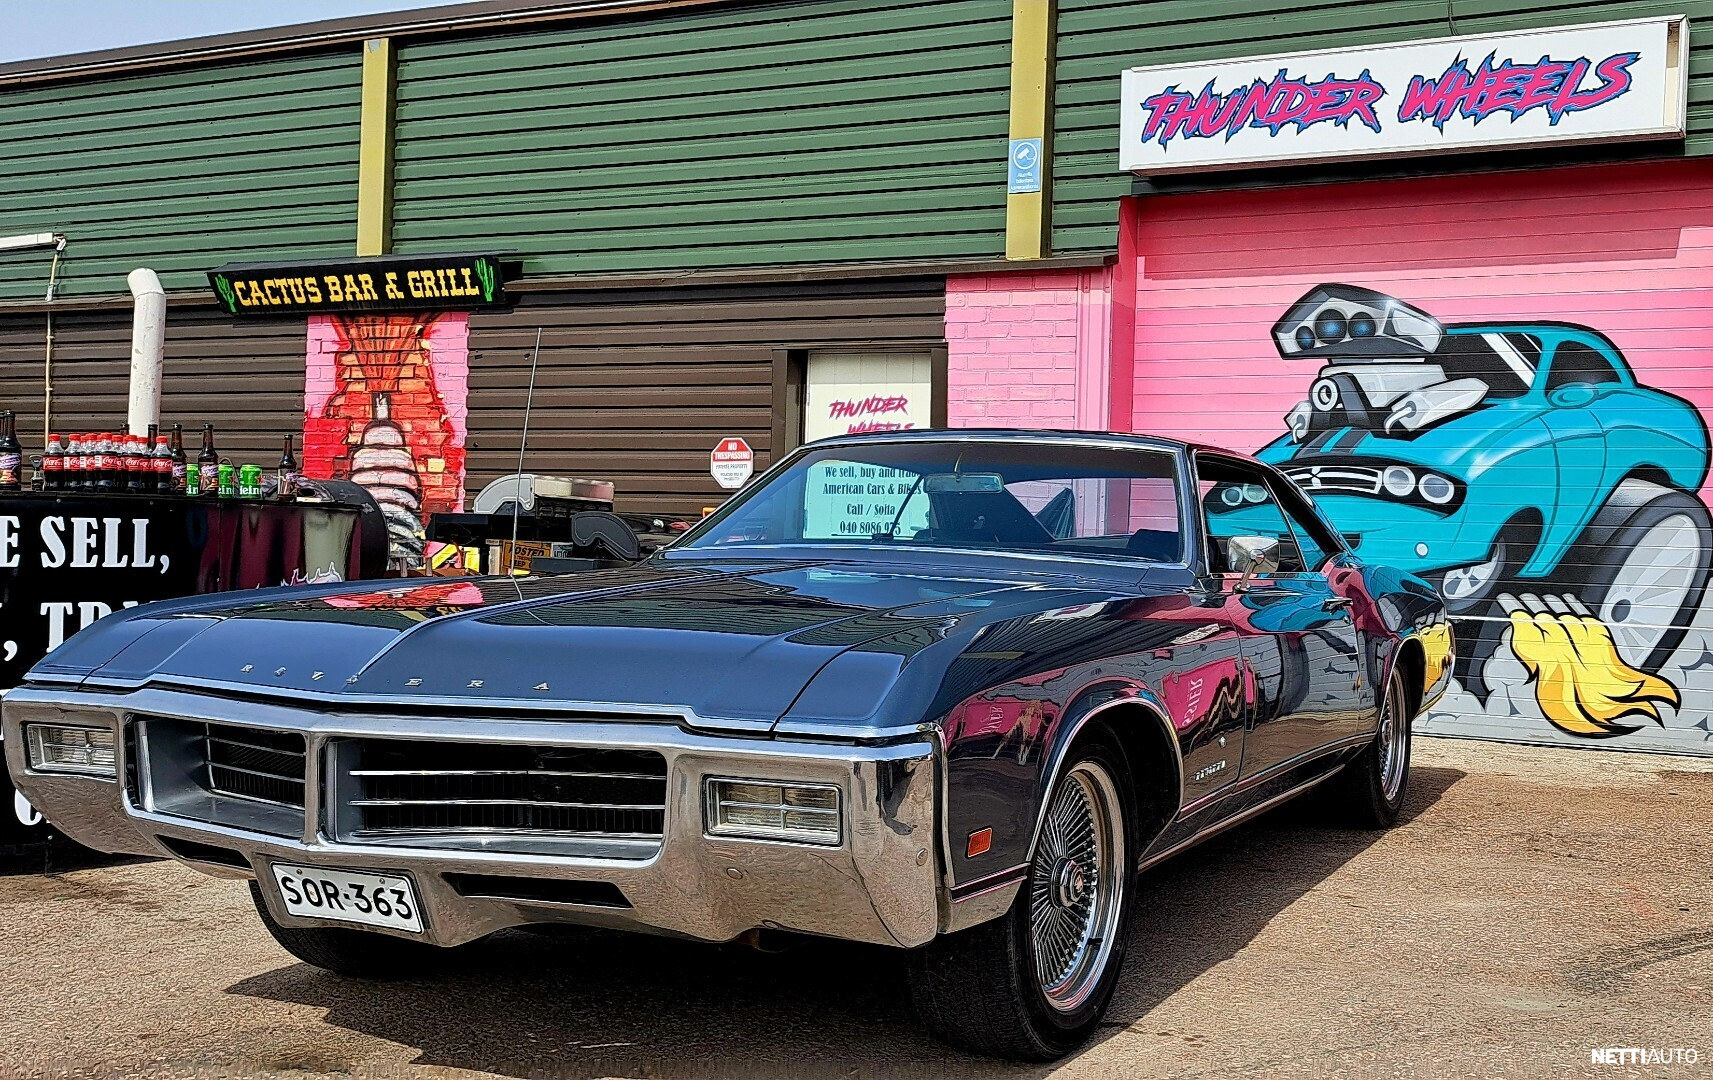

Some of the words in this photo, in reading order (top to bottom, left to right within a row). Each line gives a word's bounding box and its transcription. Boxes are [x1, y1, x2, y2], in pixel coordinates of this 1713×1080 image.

[1140, 68, 1389, 153] THUNDER
[1397, 48, 1642, 136] WHEELS
[234, 277, 322, 306] CACTUS
[324, 273, 378, 302] BAR
[385, 272, 405, 299] &
[407, 268, 480, 298] GRILL
[828, 393, 909, 420] THUNDER
[727, 441, 738, 451] NO
[825, 466, 837, 477] We
[839, 466, 858, 479] sell,
[860, 467, 876, 481] buy
[878, 467, 896, 478] and
[823, 483, 864, 494] American
[866, 483, 885, 494] Cars
[887, 484, 895, 494] &
[846, 503, 863, 515] Call
[866, 504, 872, 515] /
[874, 504, 896, 515] Soita
[840, 521, 857, 533] 040
[860, 521, 881, 535] 8086
[40, 515, 170, 574] SELL,
[281, 875, 413, 920] SOR-363
